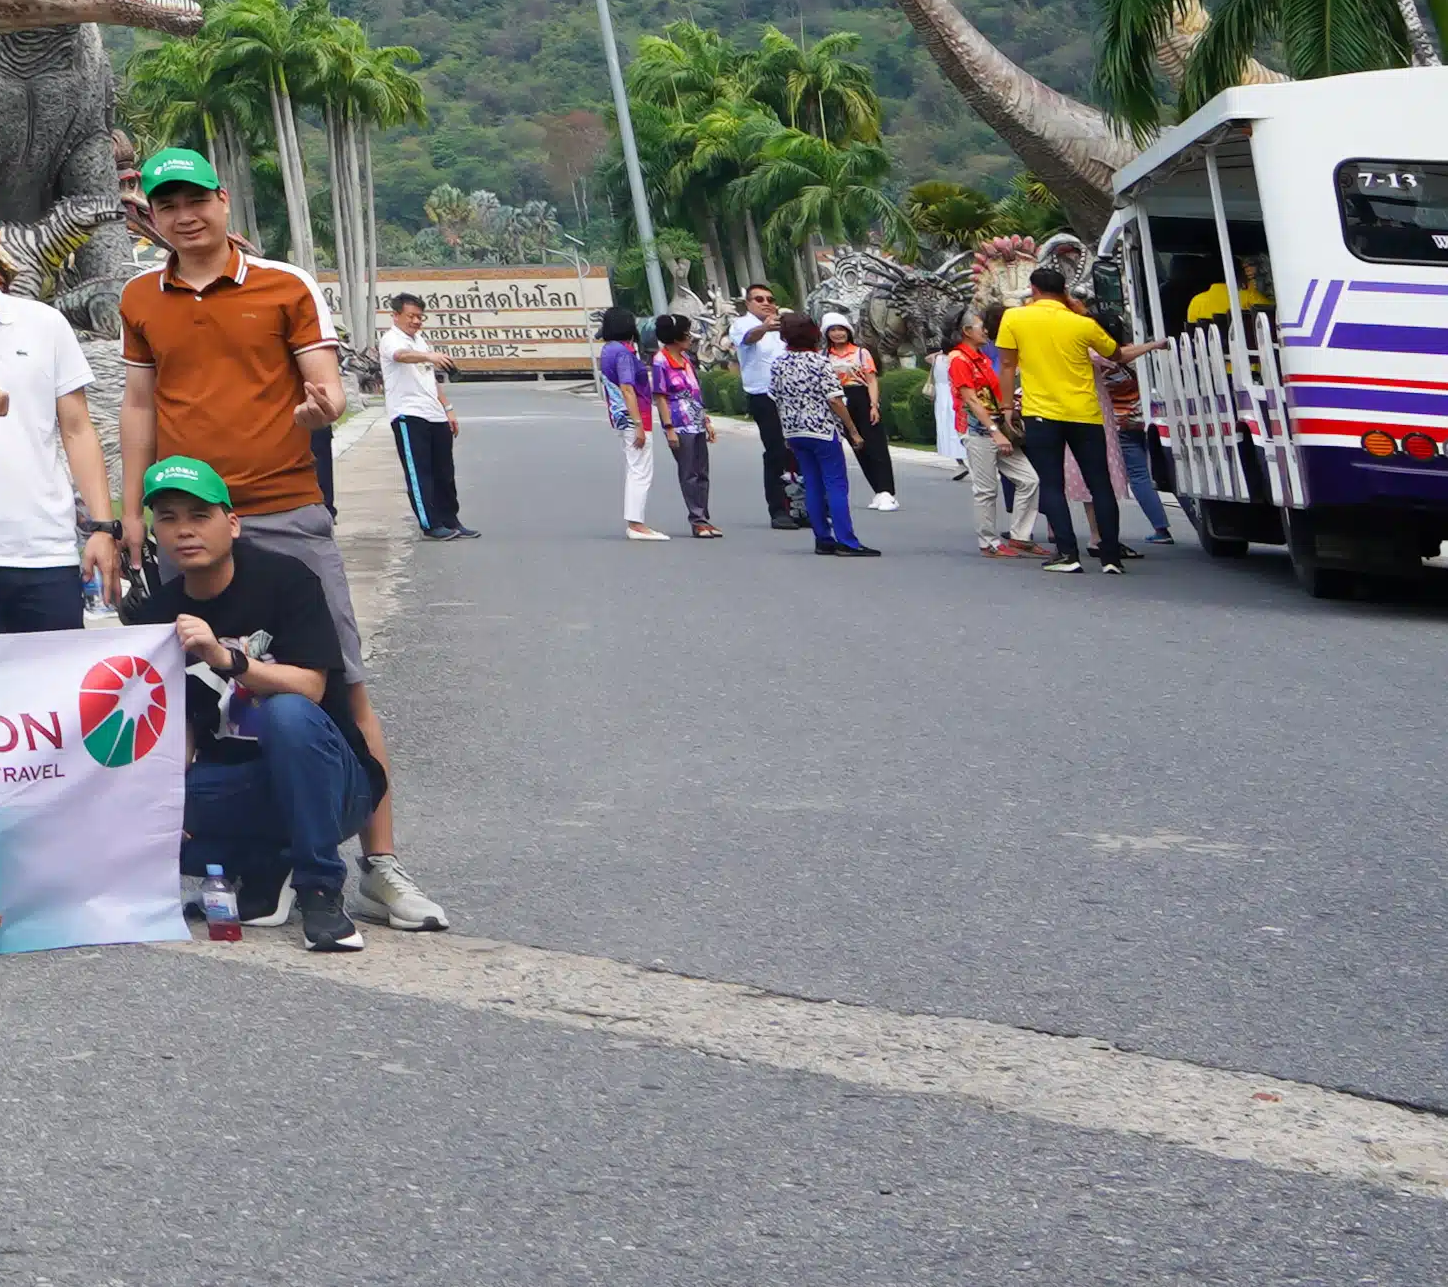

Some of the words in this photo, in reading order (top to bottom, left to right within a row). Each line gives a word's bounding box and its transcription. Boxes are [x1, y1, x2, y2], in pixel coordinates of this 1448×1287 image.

[1358, 172, 1417, 188] 7-13
[436, 313, 472, 326] TEN
[421, 328, 477, 340] ARDENS
[482, 328, 499, 339] IN
[503, 328, 533, 340] THE
